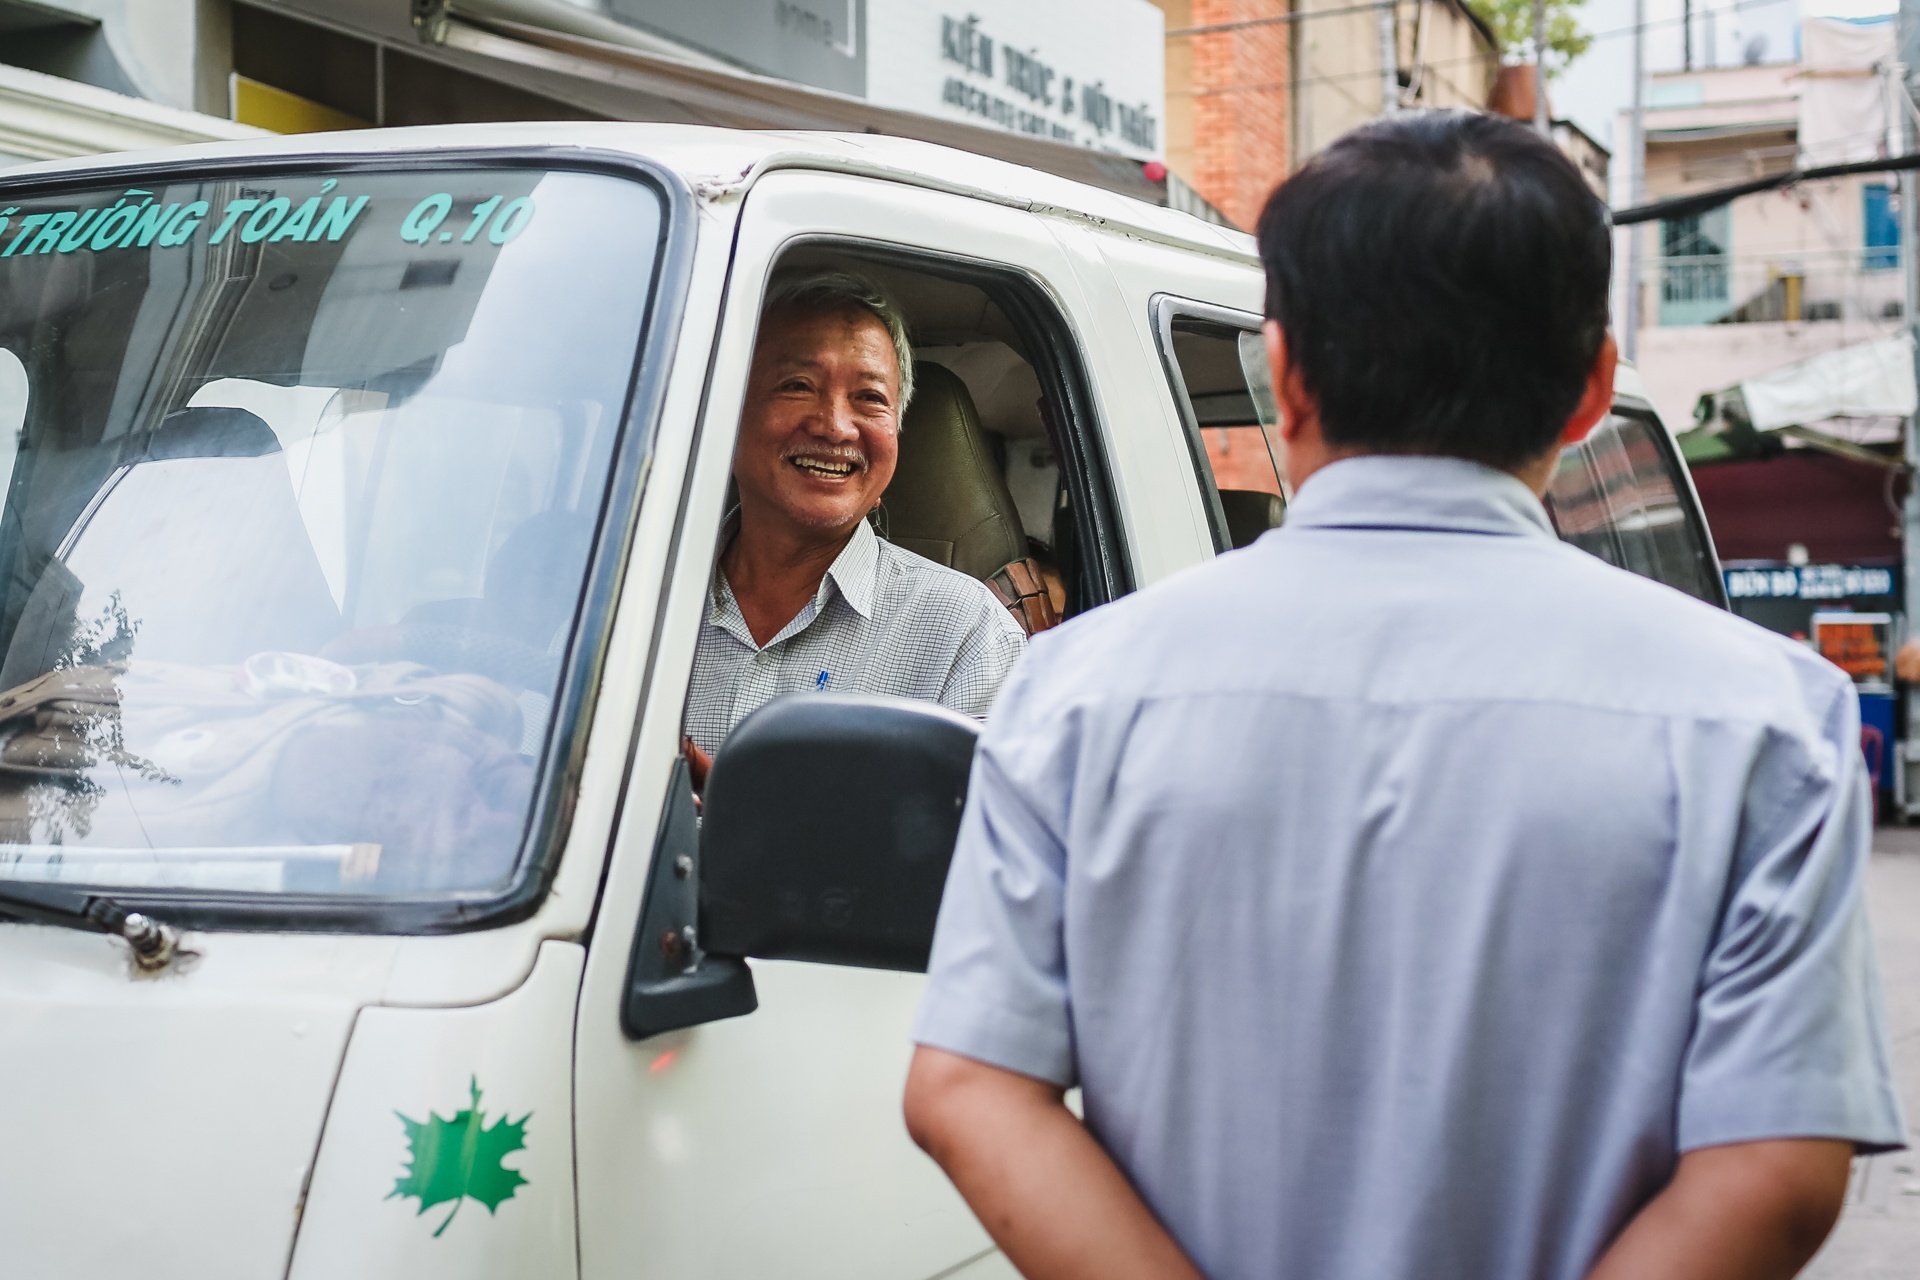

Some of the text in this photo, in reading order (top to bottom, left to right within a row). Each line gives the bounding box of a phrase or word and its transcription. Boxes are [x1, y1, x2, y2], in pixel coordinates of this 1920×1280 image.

[1, 189, 209, 258] TRƯỜNG
[208, 178, 370, 244] TOẢN
[400, 192, 536, 245] Q.10
